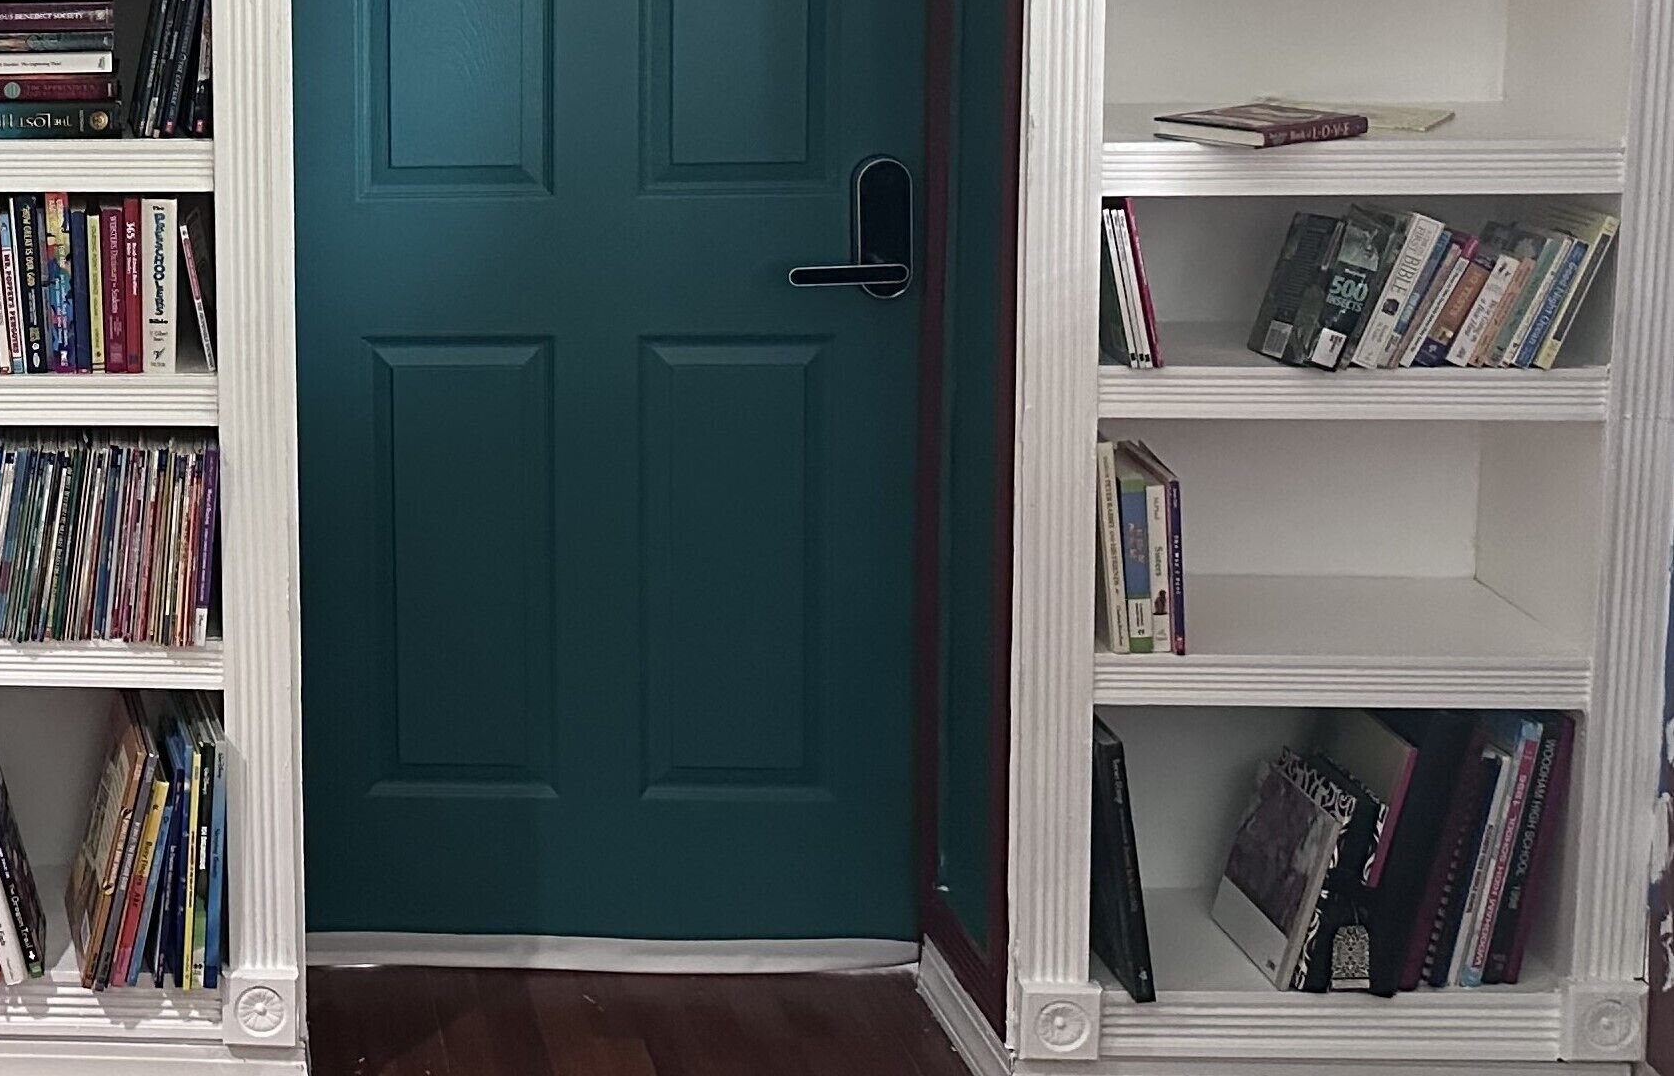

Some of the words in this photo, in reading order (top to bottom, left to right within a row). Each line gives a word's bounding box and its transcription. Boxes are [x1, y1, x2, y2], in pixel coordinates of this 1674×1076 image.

[18, 112, 51, 128] LOST
[1329, 277, 1368, 303] 500
[1391, 253, 1422, 294] BIBLE
[1476, 899, 1496, 967] WOODHAM
[1492, 867, 1504, 898] HIGH
[1499, 816, 1517, 864] SCHOOL
